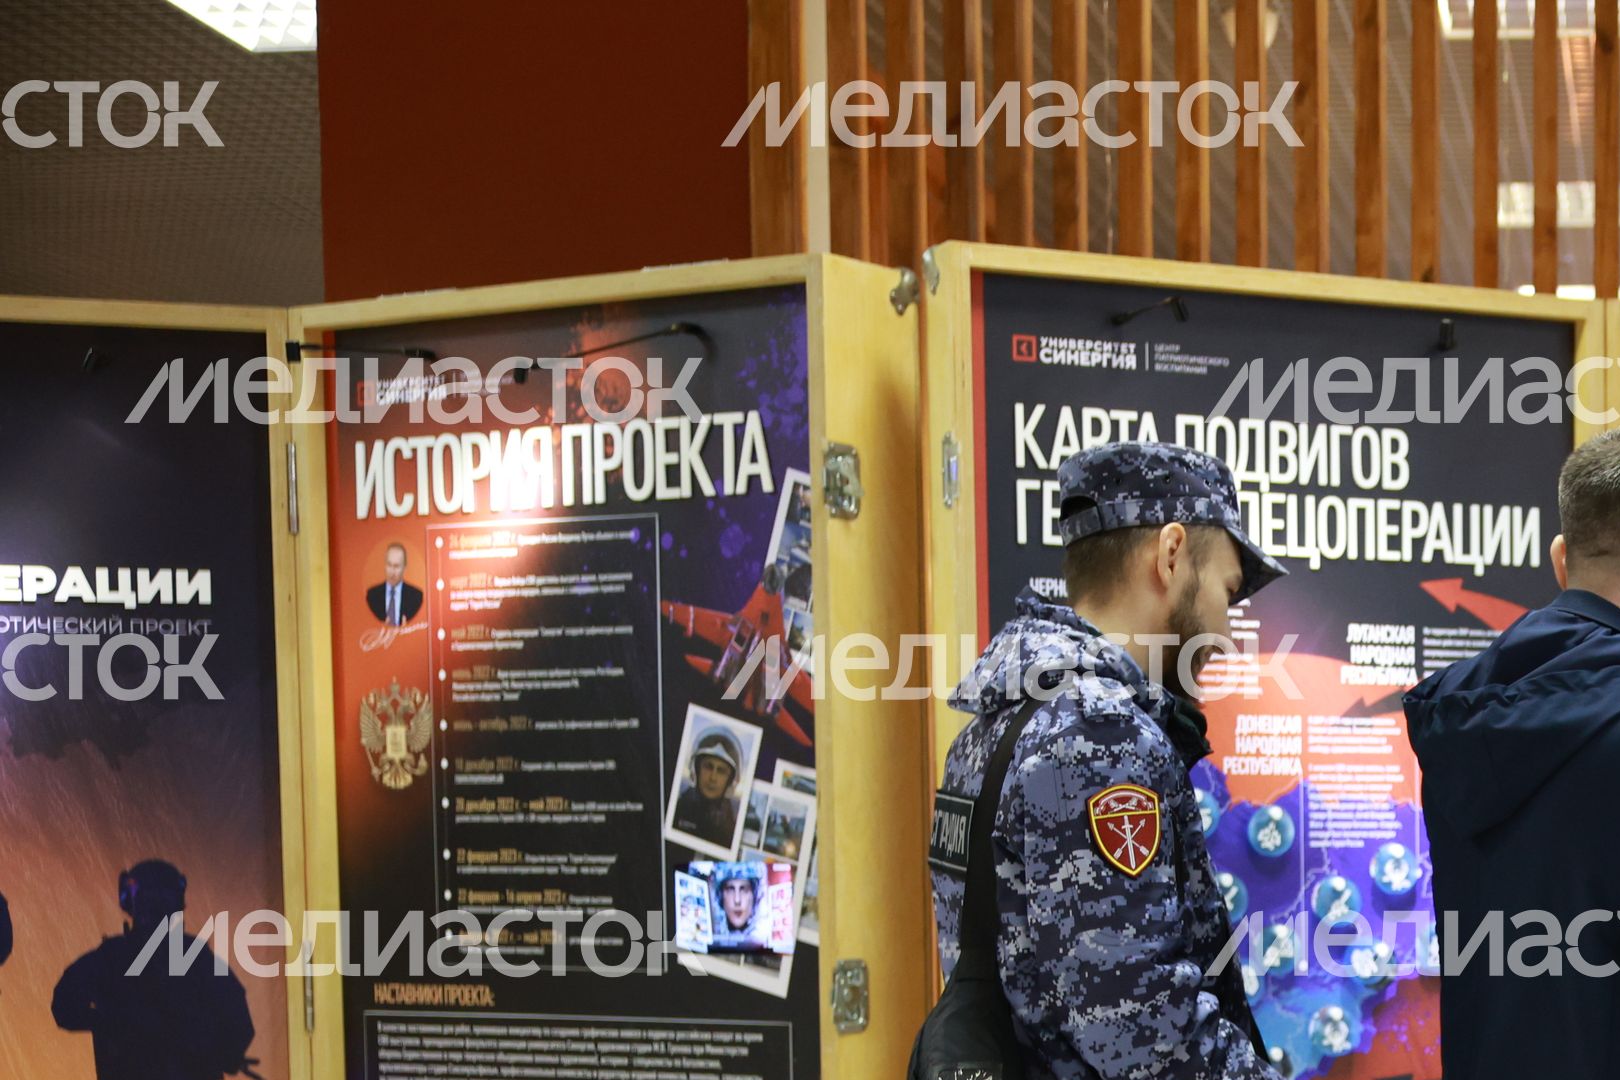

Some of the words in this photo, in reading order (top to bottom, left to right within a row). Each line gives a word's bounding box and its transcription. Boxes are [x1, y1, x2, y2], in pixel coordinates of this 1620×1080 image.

[1040, 336, 1136, 354] УНИВЕРСИТЕТ
[1039, 348, 1137, 370] СИНЕРГИЯ
[1175, 414, 1411, 493] ПОДВИГОВ
[354, 423, 553, 520] ИСТОРИЯ
[559, 410, 775, 510] ПРОЕКТА
[1238, 490, 1541, 577] ПЕЦОПЕРАЦИИ
[1346, 623, 1416, 643] ЛУГАНСКАЯ
[1350, 645, 1416, 666] НАРОДНАЯ
[1341, 665, 1418, 685] РЕСПУБЛИКА
[1235, 715, 1301, 735] ДОНЕЦКАЯ
[1235, 736, 1302, 757] НАРОДНАЯ
[1223, 756, 1303, 775] РЕСПУБЛИКА
